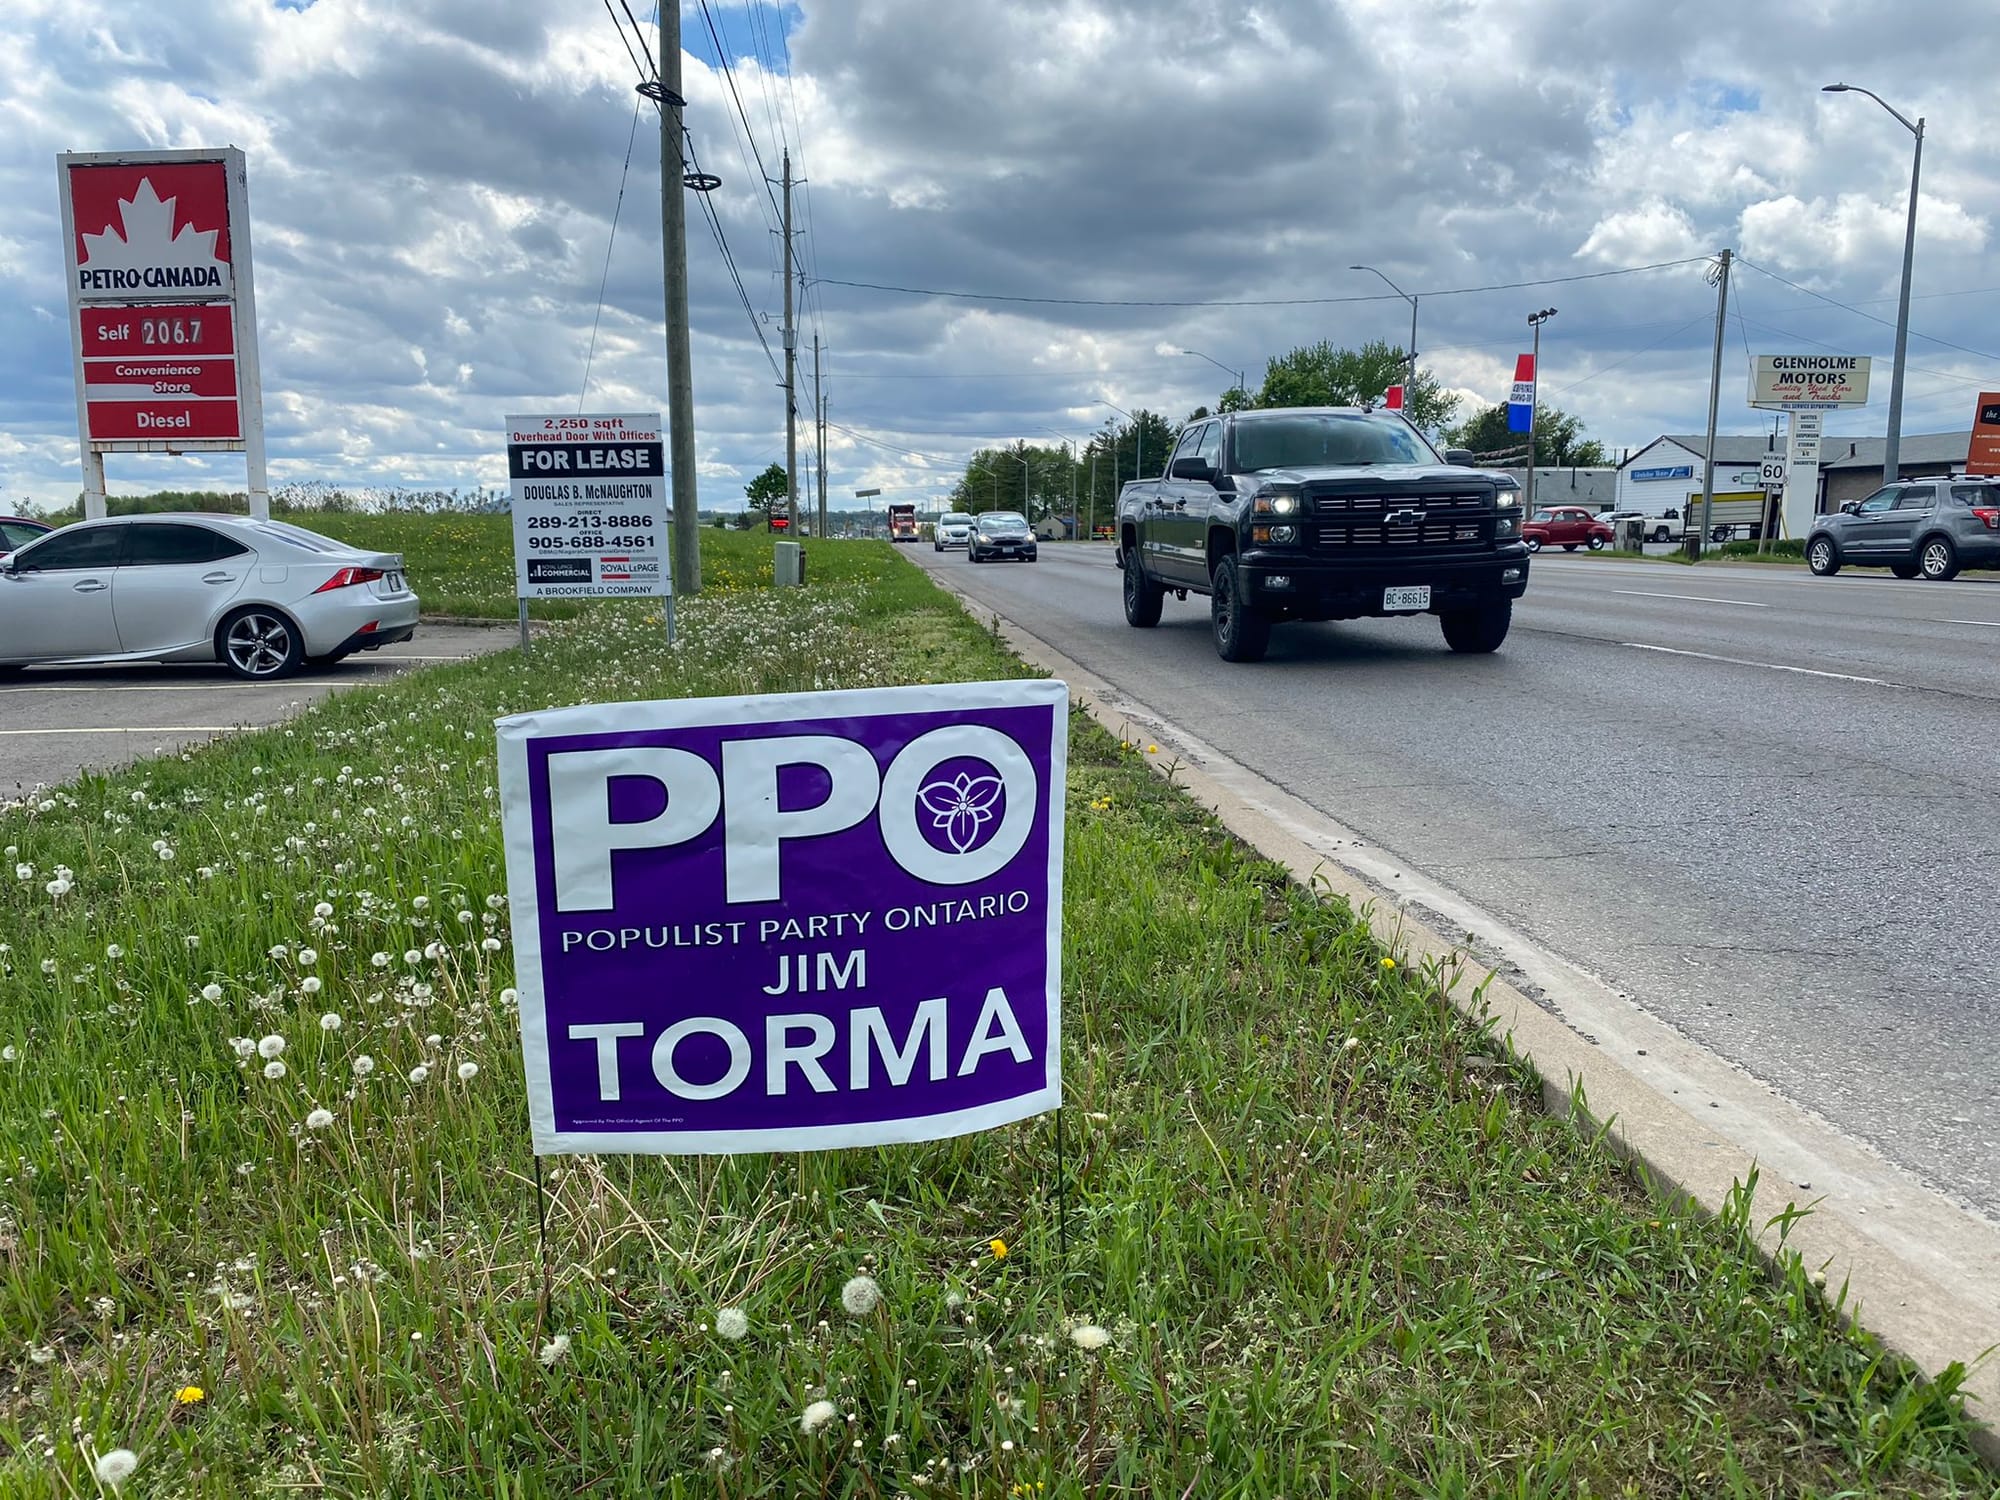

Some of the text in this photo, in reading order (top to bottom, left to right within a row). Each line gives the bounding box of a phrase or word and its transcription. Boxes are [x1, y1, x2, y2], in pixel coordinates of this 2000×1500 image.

[98, 321, 201, 344] Self 206.7
[115, 363, 201, 376] Convenience
[1773, 357, 1856, 369] GLENHOLME
[1779, 373, 1846, 384] MOTORS
[153, 381, 191, 393] Store
[1771, 384, 1802, 392] Quality
[1832, 383, 1852, 392] Cars
[1809, 391, 1841, 400] Trucks
[137, 411, 191, 427] Diesel
[544, 418, 623, 430] 2,250 sqft
[513, 430, 656, 442] Overhead Door With Offices
[522, 449, 651, 470] FOR LEASE
[1763, 464, 1783, 478] 60
[524, 484, 652, 500] DOUGLAS B. McNAUGHTON
[527, 515, 653, 529] 289-213-8886
[528, 535, 654, 548] 905-688-4561
[601, 564, 628, 572] ROYAL
[537, 586, 653, 595] A BROOKFIELD COMPANY
[547, 724, 1037, 913] PPO
[562, 889, 1030, 953] POPULIST PARTY ONTARIO
[762, 949, 867, 995] JIM
[568, 986, 1033, 1102] TORMA
